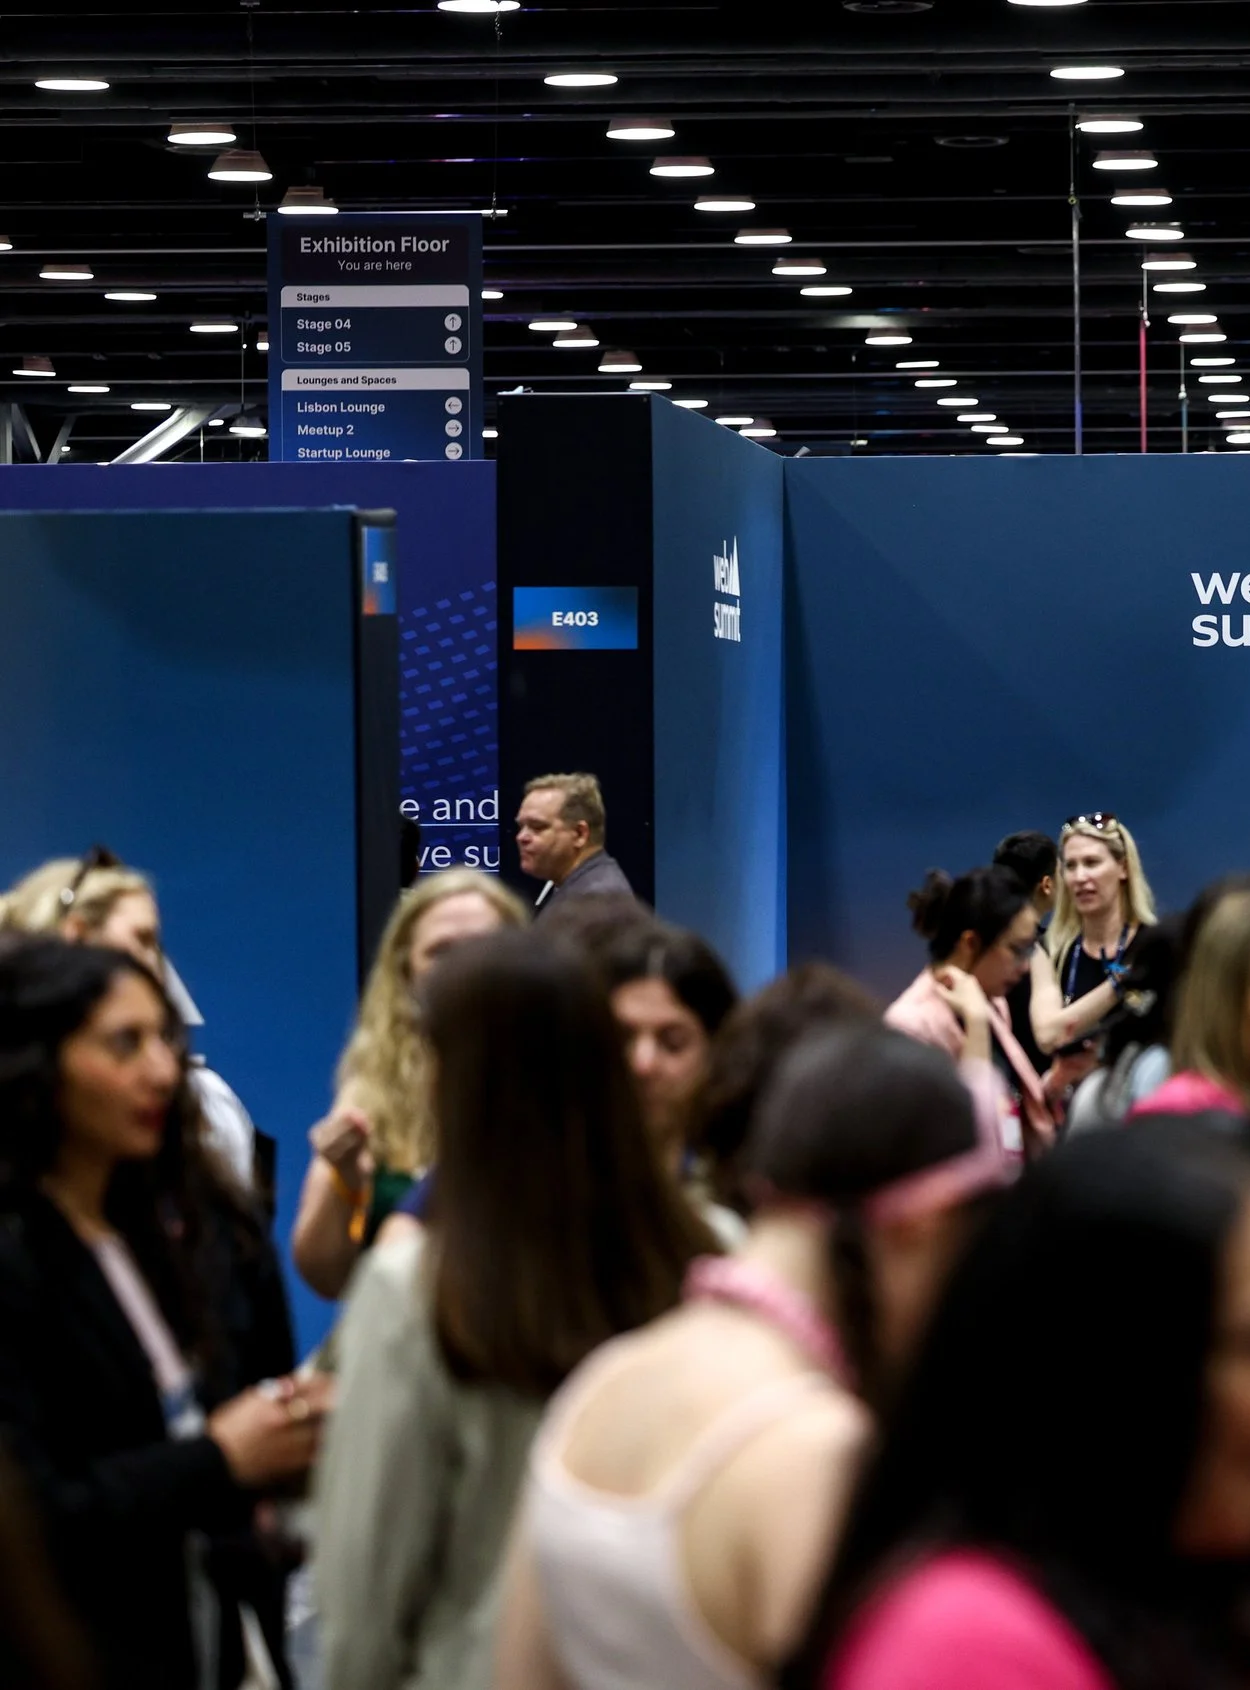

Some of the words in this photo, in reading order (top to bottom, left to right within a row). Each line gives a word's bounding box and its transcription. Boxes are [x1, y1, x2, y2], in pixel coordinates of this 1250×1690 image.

[300, 236, 396, 253] Exhibition
[400, 236, 450, 253] Floor
[337, 260, 361, 271] You
[363, 262, 382, 271] are
[386, 260, 412, 271] here
[296, 293, 330, 303] Stages
[297, 319, 332, 332] Stage
[334, 319, 351, 330] 04
[297, 341, 332, 355] Stage
[334, 341, 351, 353] 05
[297, 376, 339, 388] Lounges
[340, 376, 359, 386] and
[361, 376, 397, 388] Spaces
[297, 402, 338, 414] Lisbon
[340, 402, 385, 415] Lounge
[297, 425, 344, 438] Meetup
[346, 425, 355, 436] 2
[297, 447, 344, 460] Startup
[346, 447, 391, 460] Lounge
[552, 611, 599, 627] E403
[433, 789, 499, 820] and
